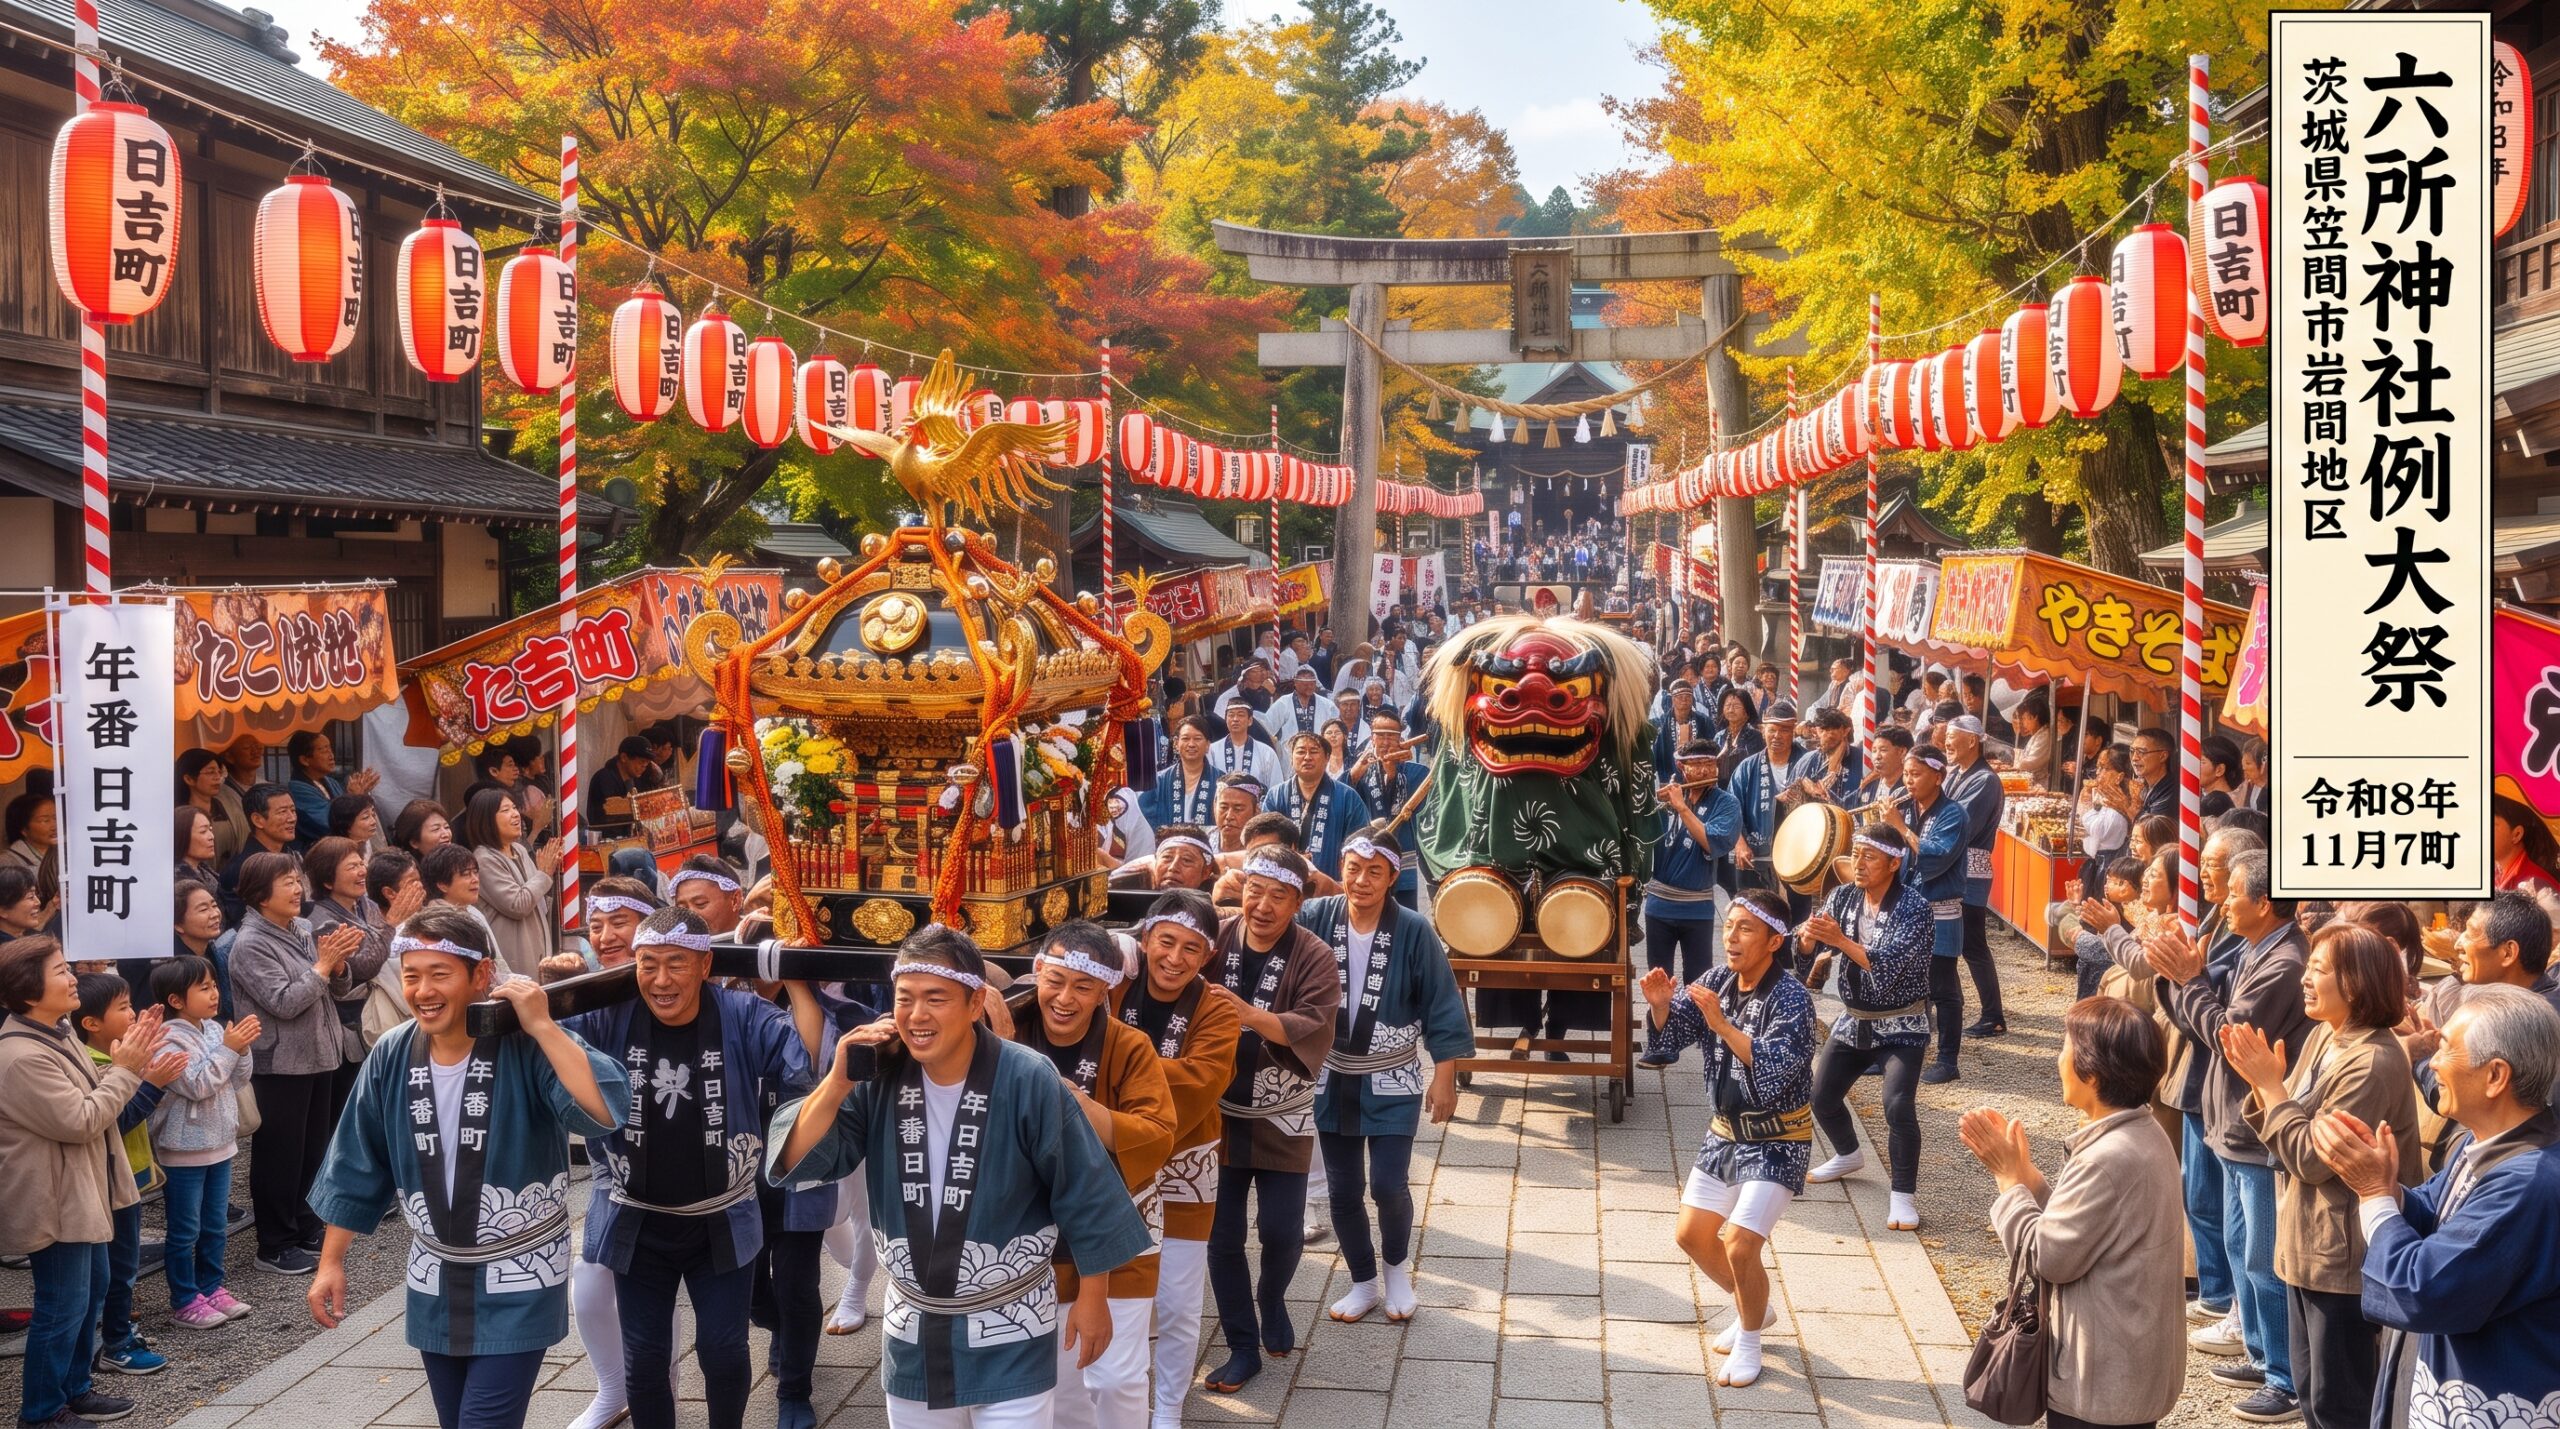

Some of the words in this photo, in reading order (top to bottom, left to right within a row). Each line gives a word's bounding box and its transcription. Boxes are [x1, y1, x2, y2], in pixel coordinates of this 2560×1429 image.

[114, 138, 169, 297] 日吉町
[2209, 201, 2260, 322] 日吉町
[448, 245, 482, 360] 日吉町
[553, 272, 576, 372] 日吉町
[660, 314, 681, 401] 日吉町
[727, 333, 747, 415] 日吉町
[463, 608, 639, 732] た吉町
[2037, 581, 2241, 687] やきそば
[85, 642, 140, 921] 年番日吉町
[461, 1058, 494, 1151] 年番町
[701, 1050, 725, 1147] 年日吉町
[898, 1085, 930, 1208] 年番日町
[943, 1090, 988, 1212] 年日吉町
